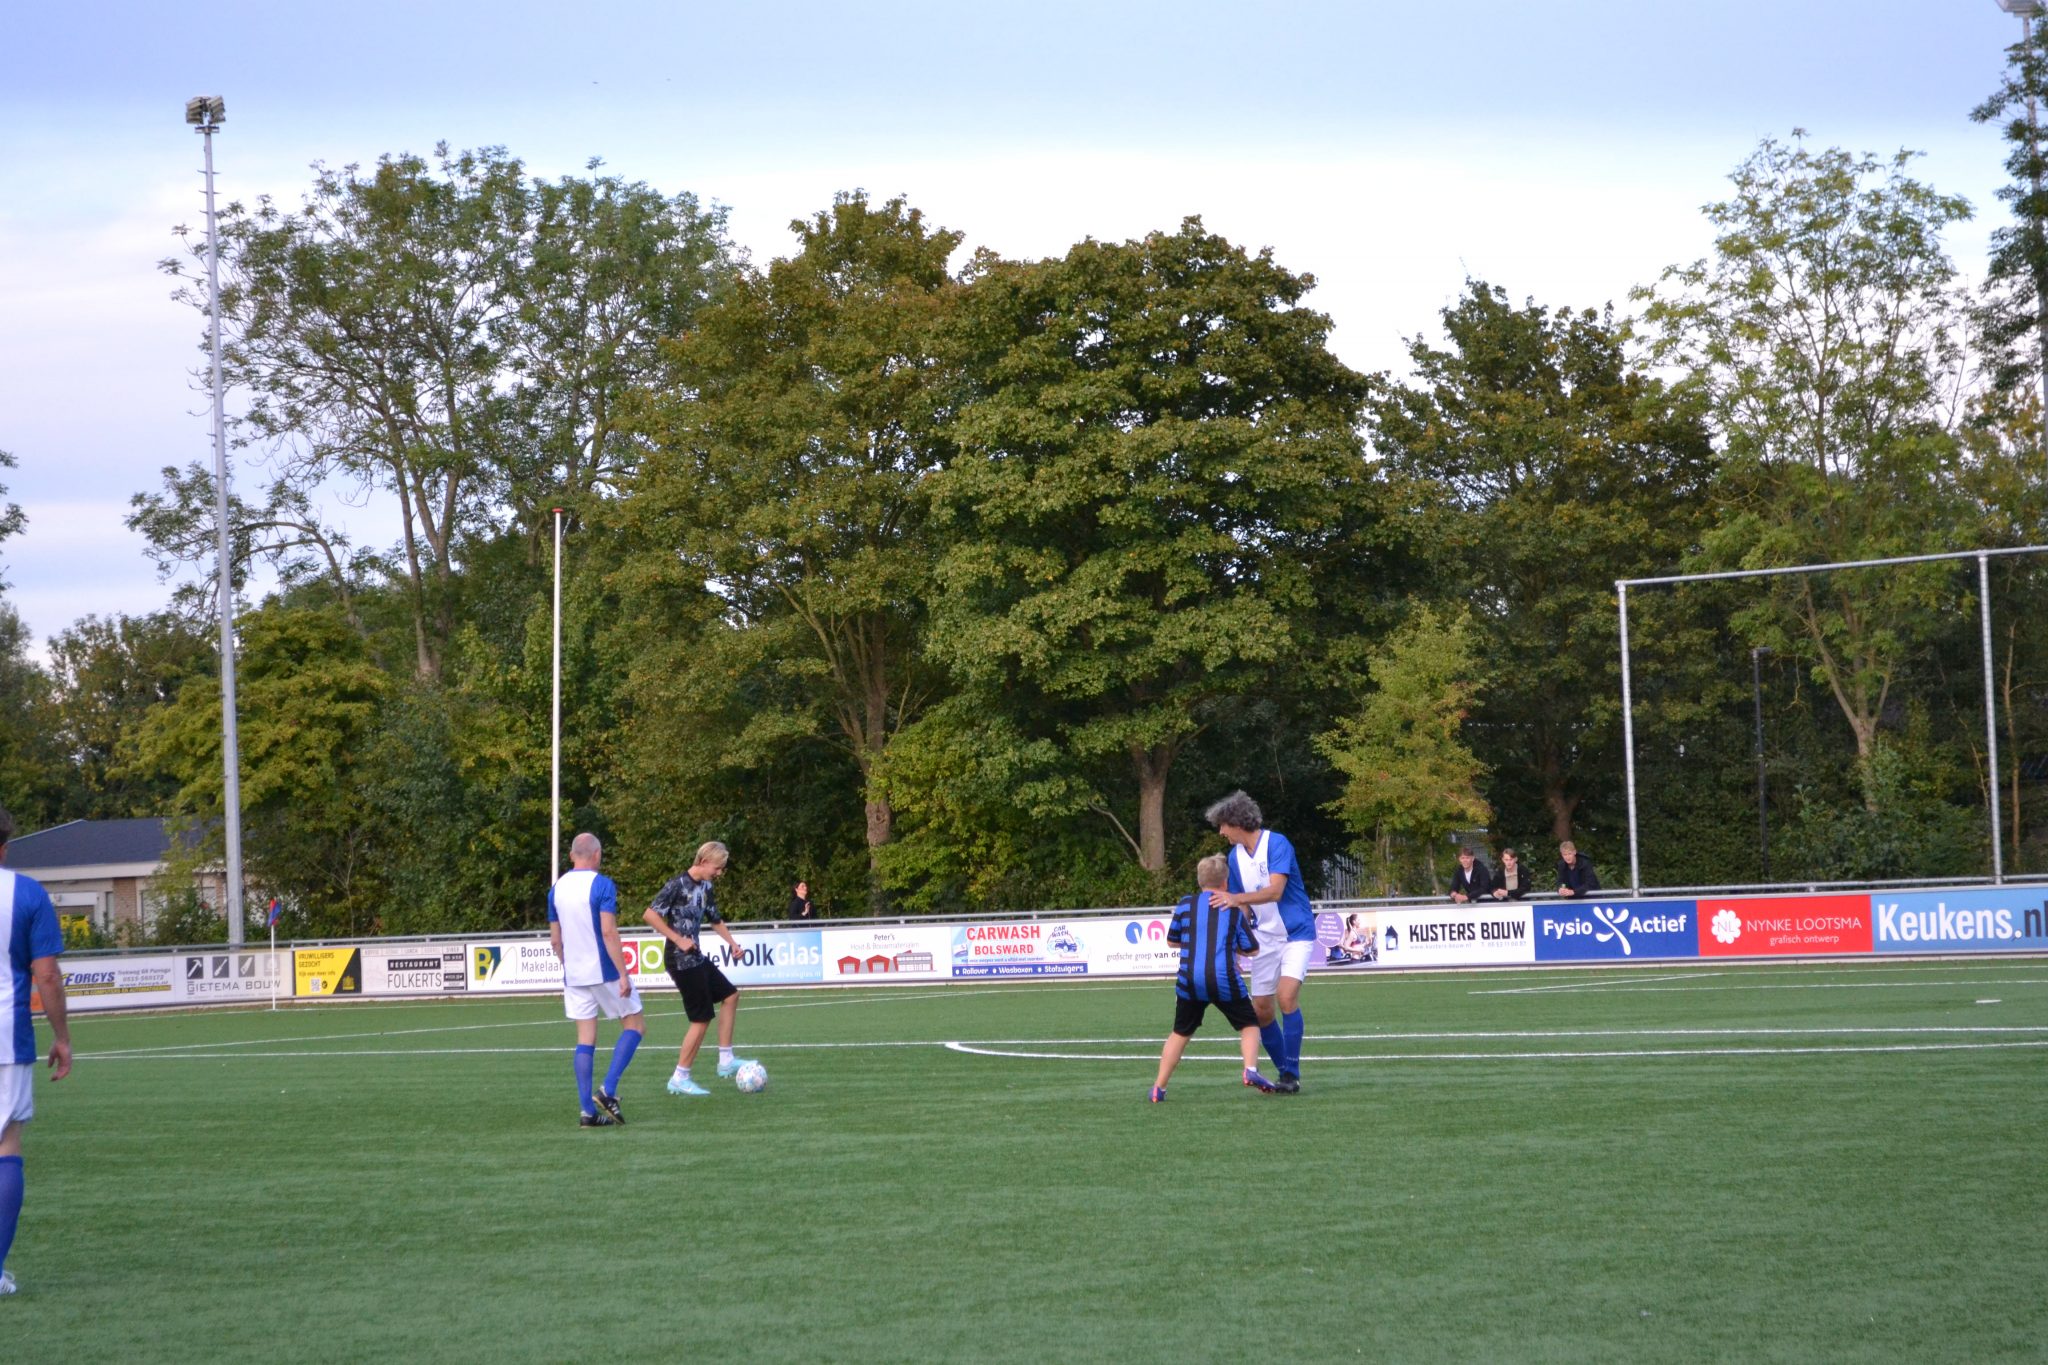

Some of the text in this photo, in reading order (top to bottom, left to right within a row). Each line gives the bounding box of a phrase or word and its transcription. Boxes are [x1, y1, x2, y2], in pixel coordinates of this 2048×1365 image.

[1543, 915, 1687, 939] Fysio Actief
[1717, 920, 1735, 933] NL
[1747, 917, 1863, 932] NYNKE LOOTSMA
[966, 925, 1041, 941] CARWASH
[1409, 921, 1526, 943] KUSTERS BOUW
[1769, 934, 1840, 947] grafisch ontwerp
[974, 944, 1034, 955] BOLSWARD
[1135, 953, 1152, 961] groep
[389, 961, 439, 969] RESTAURANT
[998, 966, 1033, 974] Wasboxen
[1044, 963, 1084, 974] Stofzuigers
[64, 972, 115, 986] FORCYS
[387, 973, 442, 989] FOLKERTS
[187, 980, 281, 994] GIETEMA BOUW
